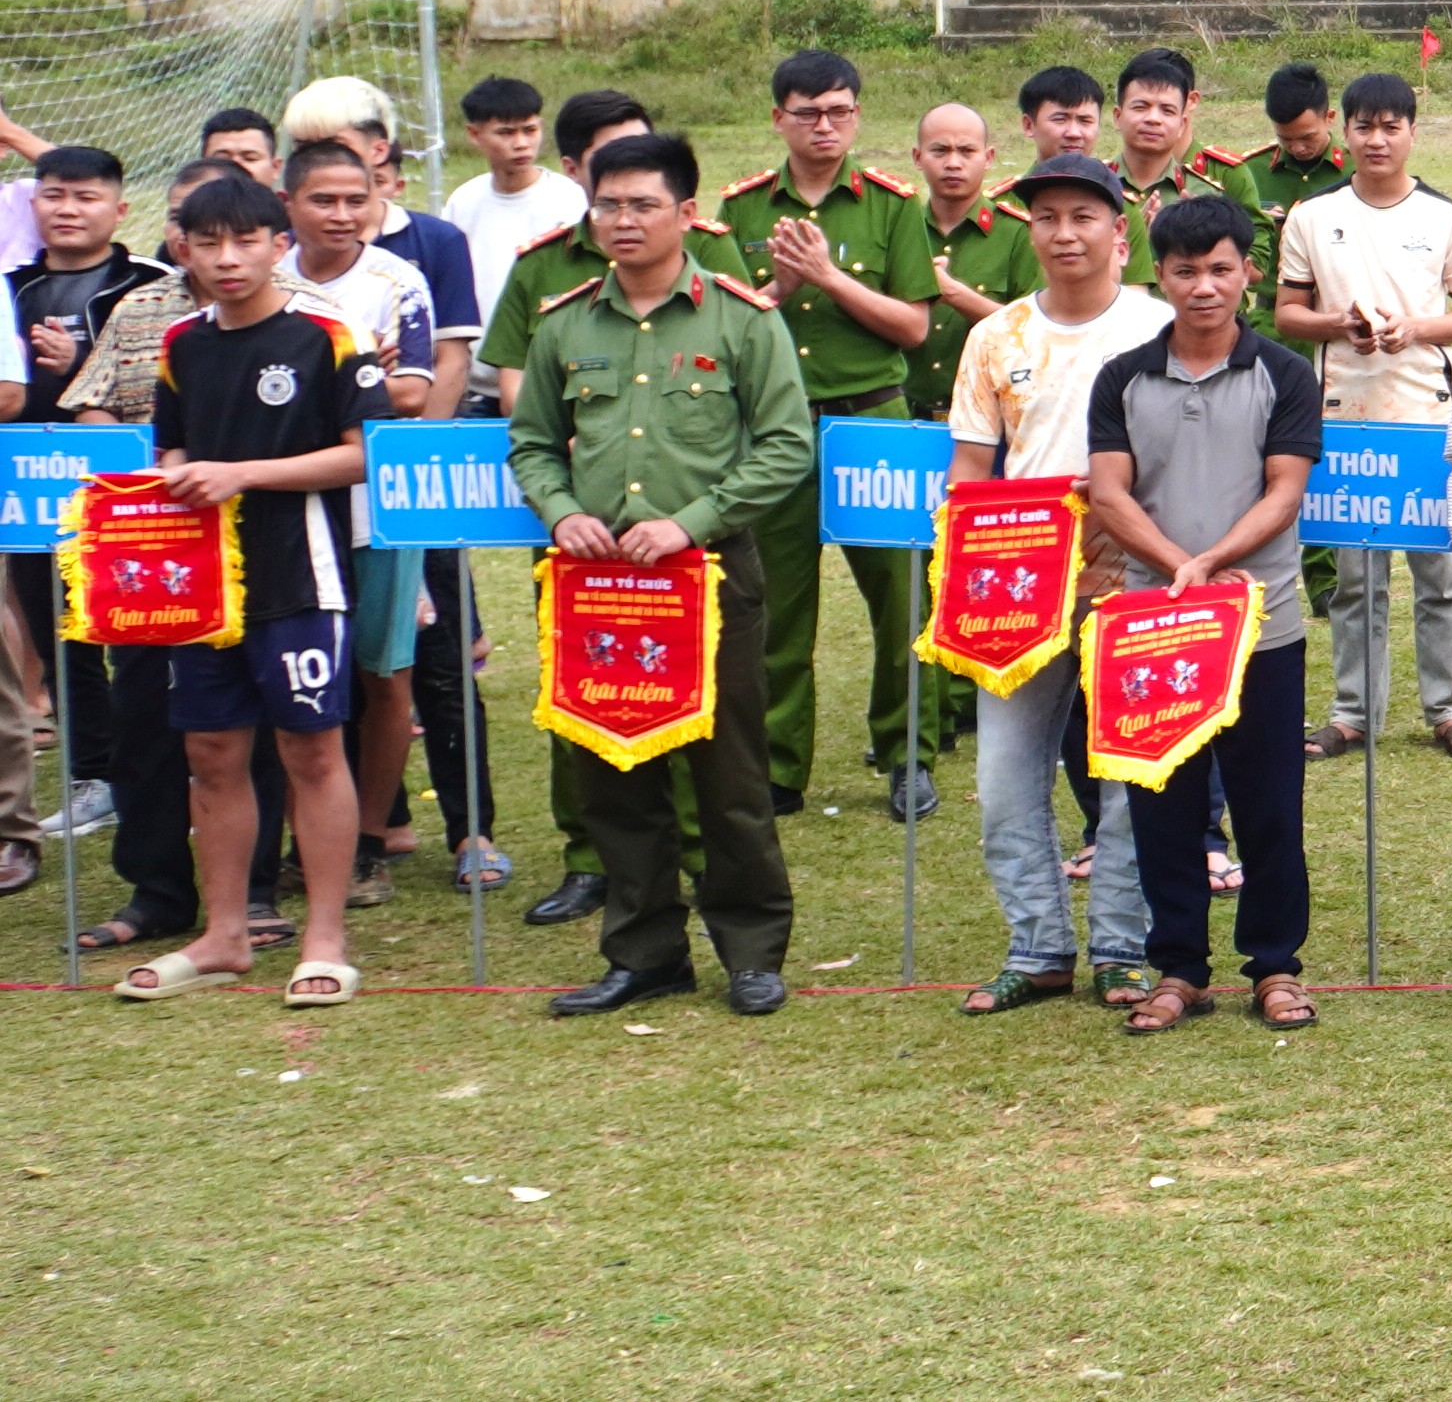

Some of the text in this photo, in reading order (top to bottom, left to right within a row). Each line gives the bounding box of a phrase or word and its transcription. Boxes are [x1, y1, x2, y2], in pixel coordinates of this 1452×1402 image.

[12, 450, 90, 479] THÔN
[1325, 448, 1398, 478] THÔN
[378, 464, 410, 510] CA
[413, 455, 448, 509] XÃ
[450, 454, 498, 508] VĂN
[833, 459, 946, 511] THÔN K
[973, 508, 1050, 526] BAN TỔ CHỨC
[1299, 484, 1448, 527] HIỀNG ẤM
[585, 574, 673, 590] BAN TỔ CHỨC
[108, 605, 201, 631] Lưu niệm
[955, 610, 1039, 639] Lưu niệm
[1127, 619, 1154, 633] BAN
[281, 648, 332, 691] 10
[578, 677, 676, 705] Lưu niệm
[1115, 699, 1203, 738] Lưu niệm
